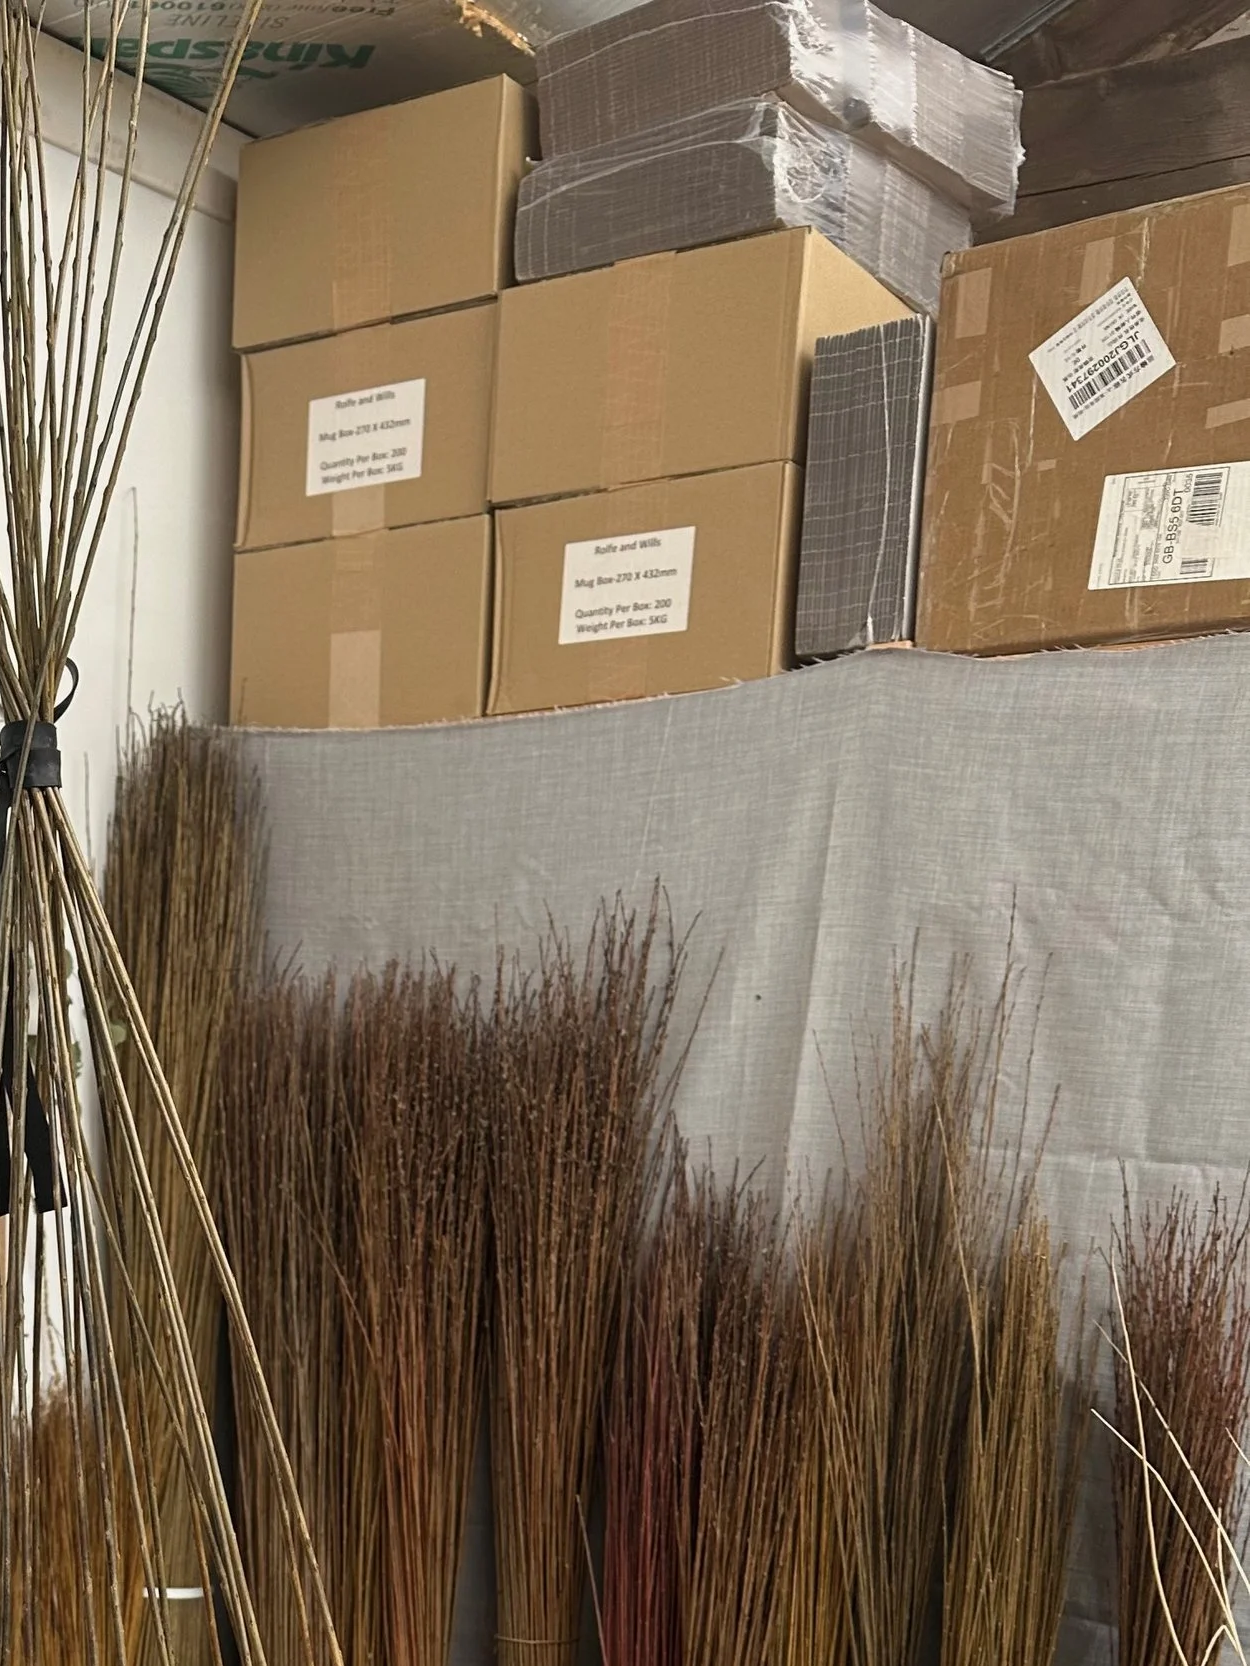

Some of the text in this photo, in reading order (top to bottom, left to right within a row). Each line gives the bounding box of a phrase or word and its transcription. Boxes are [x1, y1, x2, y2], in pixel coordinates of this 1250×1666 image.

[168, 13, 291, 29] SIELINE
[1066, 330, 1140, 393] JLGJ200297341
[358, 395, 373, 404] and
[376, 391, 395, 401] Wills
[319, 432, 336, 441] Mug
[380, 419, 410, 429] 432mm
[320, 447, 407, 470] Quantity Per Box: 200
[321, 472, 350, 484] Weight
[352, 470, 365, 479] Per
[367, 467, 384, 476] Box:
[1162, 516, 1180, 564] GB-BS5
[1171, 489, 1184, 514] 6DT
[595, 538, 662, 554] Rolfe and Wills
[575, 568, 677, 588] Mug Box-270 X 432mm
[575, 598, 672, 619] Quantity Per Box: 200
[577, 614, 668, 634] Weight Per Box: 5KG
